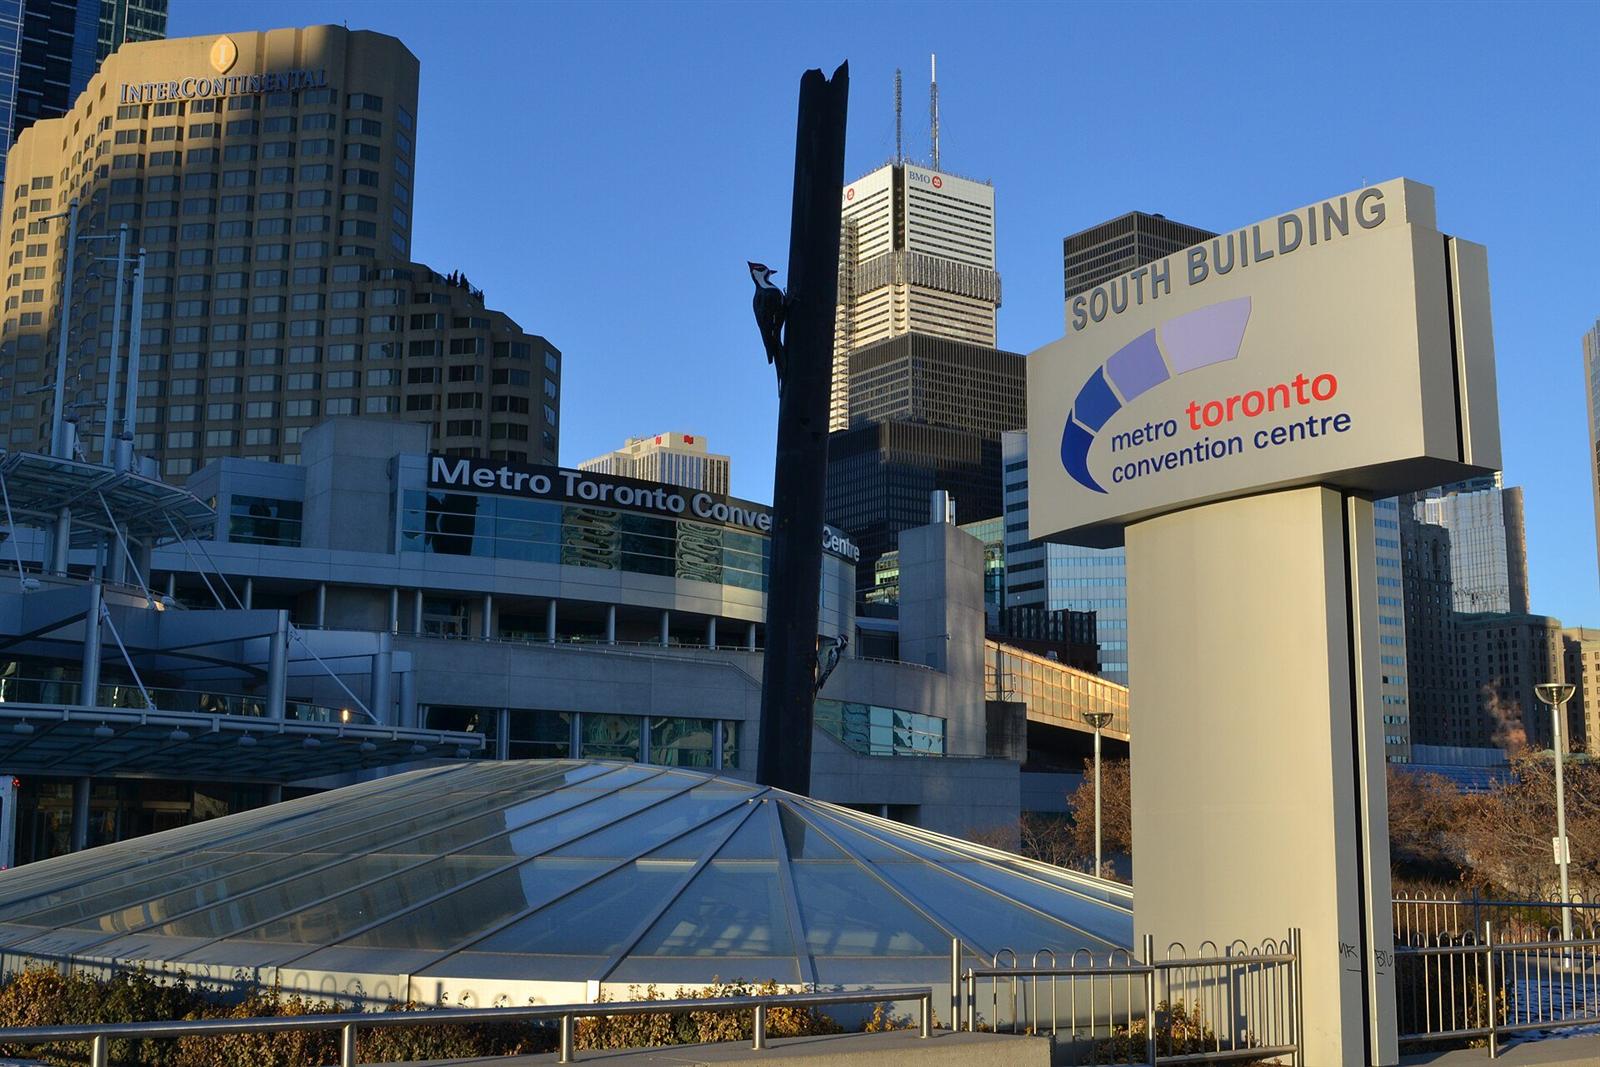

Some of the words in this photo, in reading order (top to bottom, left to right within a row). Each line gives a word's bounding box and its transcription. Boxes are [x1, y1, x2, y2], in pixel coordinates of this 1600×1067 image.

[909, 171, 930, 184] BMO
[1072, 258, 1171, 332] SOUTH
[1188, 187, 1386, 286] BUILDING
[1111, 418, 1177, 452] metro
[1185, 373, 1338, 431] toronto
[1111, 436, 1243, 483] convention
[1253, 412, 1352, 450] centre
[431, 456, 551, 495] Metro
[559, 470, 686, 514] Toronto
[692, 493, 773, 532] Conve
[822, 525, 860, 562] Centre
